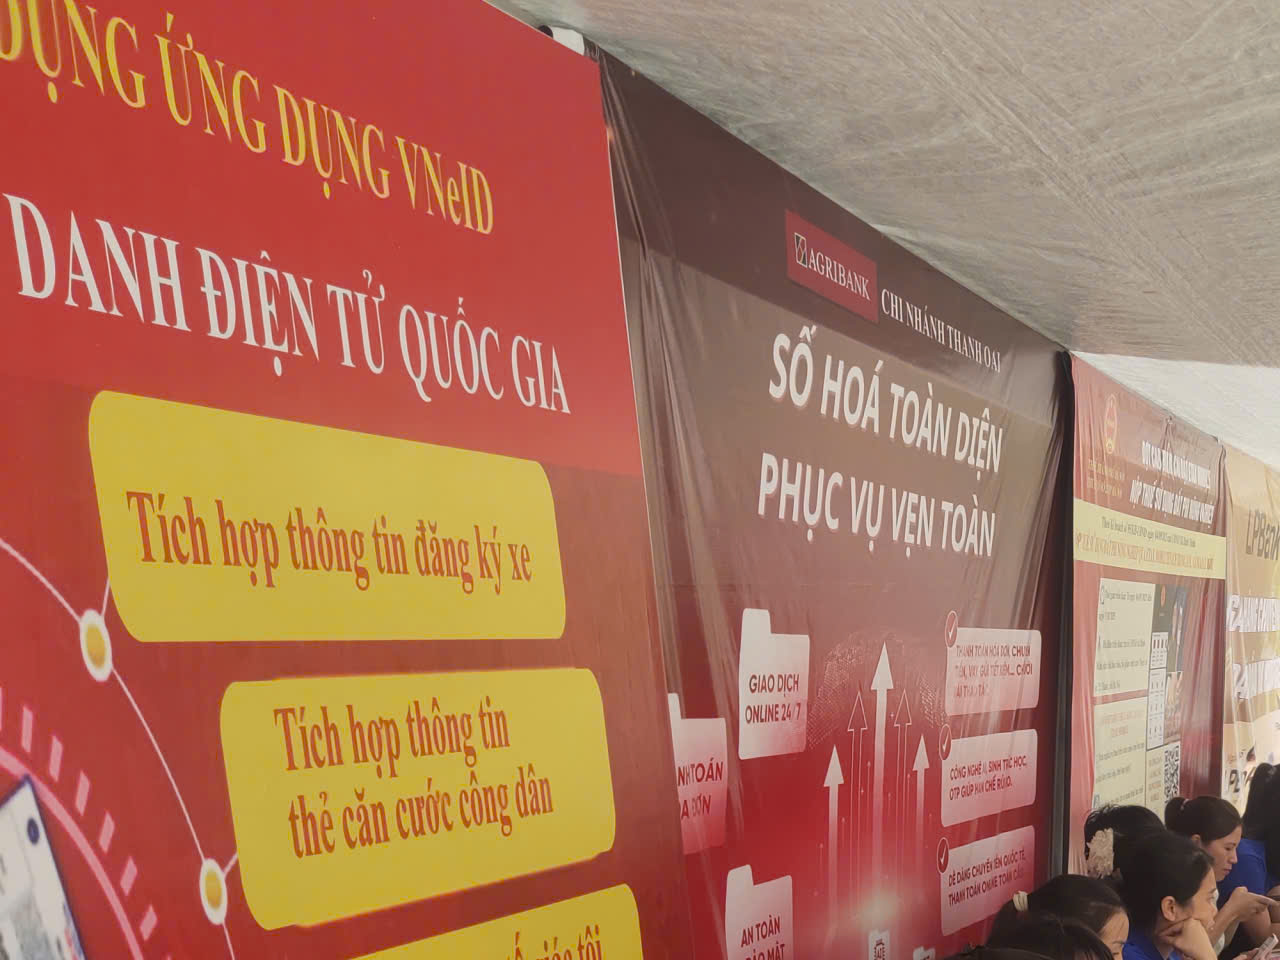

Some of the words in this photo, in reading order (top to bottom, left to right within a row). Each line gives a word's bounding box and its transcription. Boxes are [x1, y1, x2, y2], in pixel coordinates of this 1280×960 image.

[155, 13, 267, 153] ỨNG
[274, 86, 391, 199] DỤNG
[396, 136, 494, 234] VNeID
[3, 193, 192, 332] DANH
[195, 249, 320, 376] ĐIỆN
[327, 269, 386, 374] TỬ
[399, 296, 504, 402] QUỐC
[511, 332, 571, 415] GIA
[808, 248, 871, 301] AGRIBANK
[881, 288, 904, 324] CHI
[906, 301, 946, 346] NHÁNH
[947, 324, 983, 366] THANH
[768, 325, 817, 407] SỐ
[820, 355, 884, 434] HOÁ
[890, 382, 952, 457] TOÀN
[954, 407, 1003, 481] DIỆN
[126, 490, 211, 566] Tích
[215, 499, 280, 588] hợp
[286, 506, 369, 591] thông
[372, 514, 409, 575] tin
[414, 518, 475, 594] đăng
[474, 524, 502, 595] ký
[507, 541, 532, 583] xe
[758, 452, 844, 542] PHỤC
[850, 476, 884, 552] VỤ
[891, 487, 935, 559] VẸN
[941, 494, 996, 557] TOÀN
[745, 703, 779, 724] ONLINE
[749, 674, 775, 694] GIAO
[777, 673, 800, 698] DỊCH
[274, 705, 345, 772] Tích
[350, 703, 402, 779] hợp
[406, 696, 476, 768] thông
[479, 695, 510, 750] tin
[288, 789, 336, 859] thẻ
[343, 787, 390, 849] căn
[396, 776, 455, 842] cước
[460, 771, 513, 838] công
[516, 762, 554, 819] dân
[741, 926, 753, 948] AN
[755, 914, 780, 941] TOÀN
